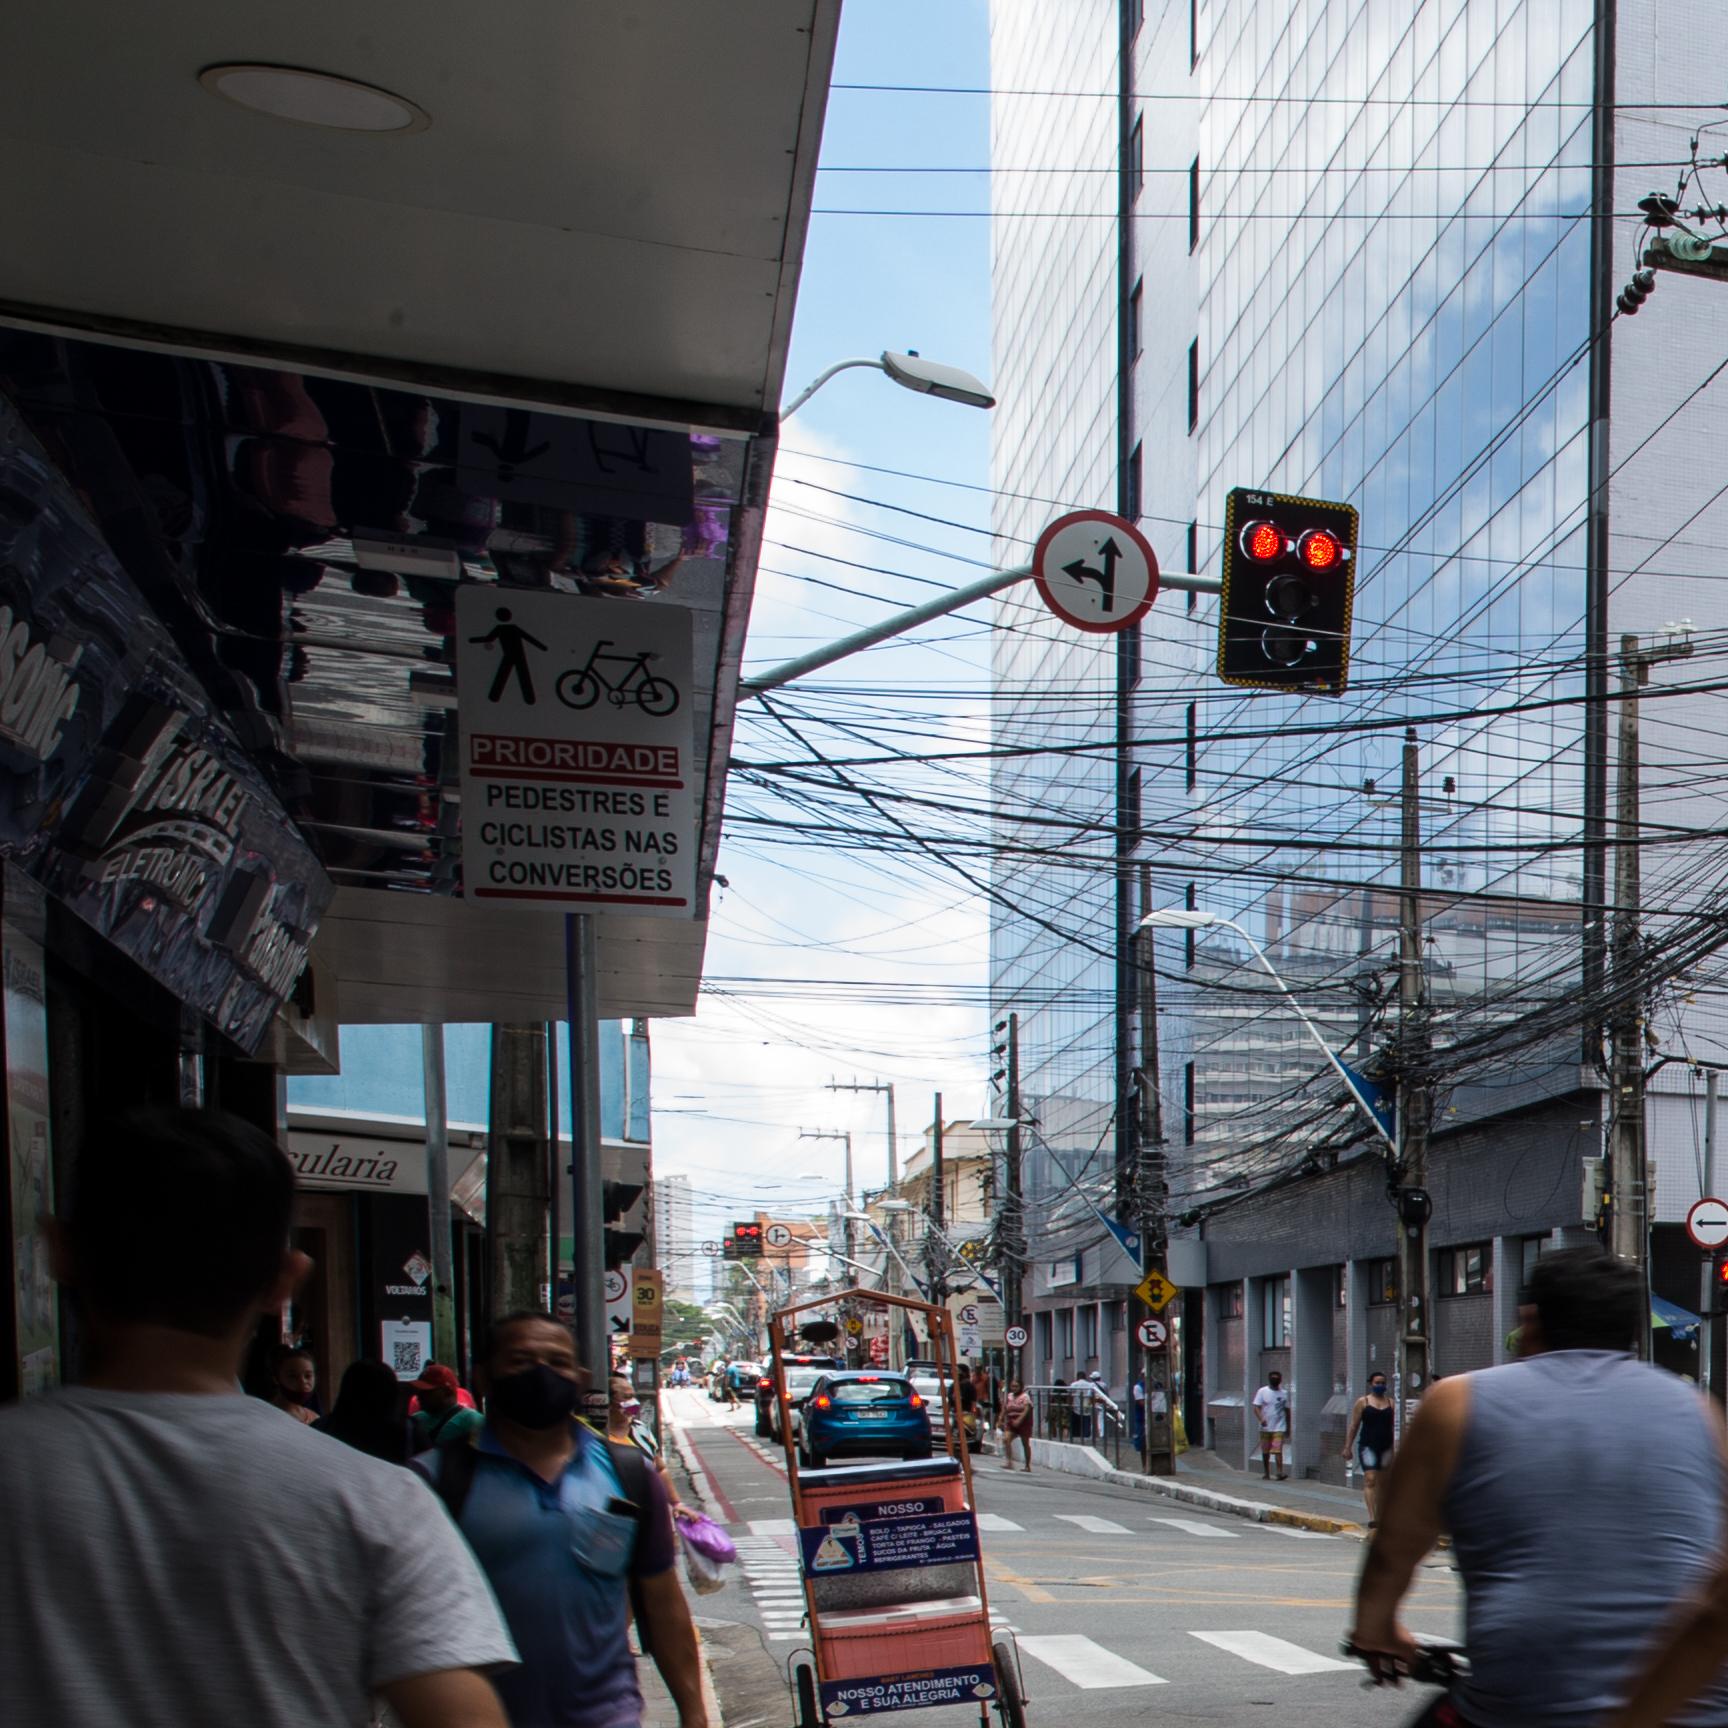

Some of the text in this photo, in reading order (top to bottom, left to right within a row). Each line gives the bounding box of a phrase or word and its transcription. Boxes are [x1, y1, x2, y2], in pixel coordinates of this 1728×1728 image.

[472, 737, 678, 773] PRIORIDADE
[487, 785, 669, 817] PEDESTRES E
[481, 822, 678, 855] CICLISTAS NAS
[489, 860, 673, 892] CONVERSÕES
[637, 1288, 655, 1300] 30
[1009, 1331, 1025, 1340] 30
[878, 1502, 925, 1516] NOSSO
[873, 1552, 929, 1564] REFRIGERANTES
[838, 1674, 980, 1701] NOSSO ATENDIMENTO
[873, 1693, 901, 1708] SUA
[902, 1688, 961, 1704] ALEGRIA
